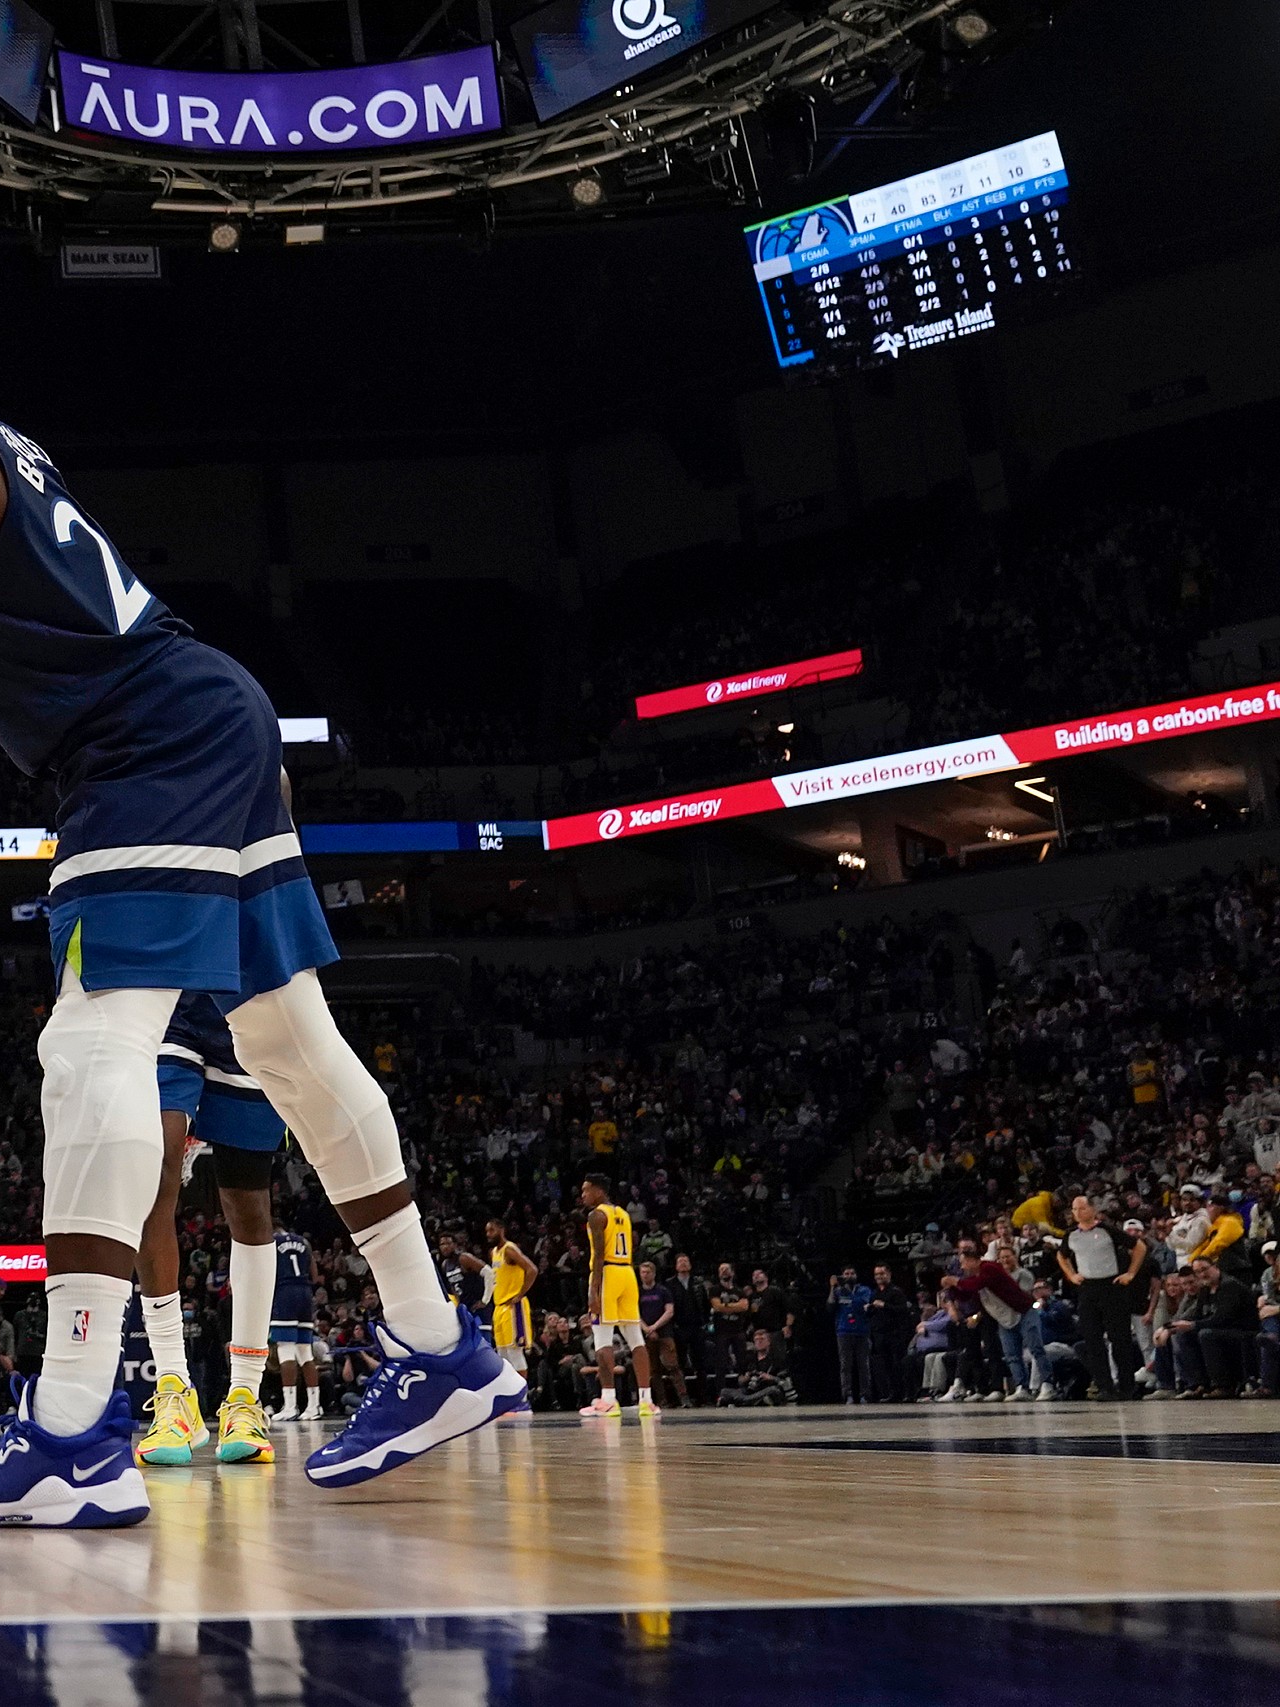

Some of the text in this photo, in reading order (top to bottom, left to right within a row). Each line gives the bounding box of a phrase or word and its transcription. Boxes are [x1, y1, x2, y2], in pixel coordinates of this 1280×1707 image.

[863, 212, 876, 224] 47
[891, 204, 906, 215] 40
[921, 194, 937, 207] 83
[949, 184, 964, 198] 27
[980, 176, 992, 188] 11
[1008, 166, 1024, 179] 10
[1042, 158, 1051, 169] 3
[903, 233, 923, 250] 0/1
[970, 216, 980, 229] 3
[1020, 200, 1029, 213] 0
[70, 250, 150, 266] MALIK SEALY
[814, 276, 841, 293] 6/12
[907, 249, 928, 265] 3/4
[974, 232, 983, 245] 3
[1024, 217, 1033, 230] 1
[818, 293, 838, 309] 2/4
[912, 265, 932, 280] 1/1
[979, 248, 989, 261] 2
[1028, 233, 1037, 246] 1
[1050, 226, 1059, 239] 7
[823, 308, 842, 324] 1/1
[915, 281, 936, 296] 0/0
[983, 264, 991, 276] 1
[1032, 249, 1042, 262] 2
[826, 324, 846, 339] 4/6
[919, 296, 941, 313] 2/2
[986, 280, 996, 293] 0
[1037, 265, 1047, 278] 0
[1057, 258, 1071, 272] 11
[903, 318, 955, 343] Treasure
[954, 304, 993, 329] Island
[1055, 721, 1134, 750] Building
[1137, 718, 1150, 735] a
[1152, 697, 1265, 732] carbon-free
[790, 749, 996, 797] Visit xcelenergy.com
[478, 823, 502, 837] MIL
[479, 837, 503, 850] SAC
[289, 1254, 301, 1277] 1
